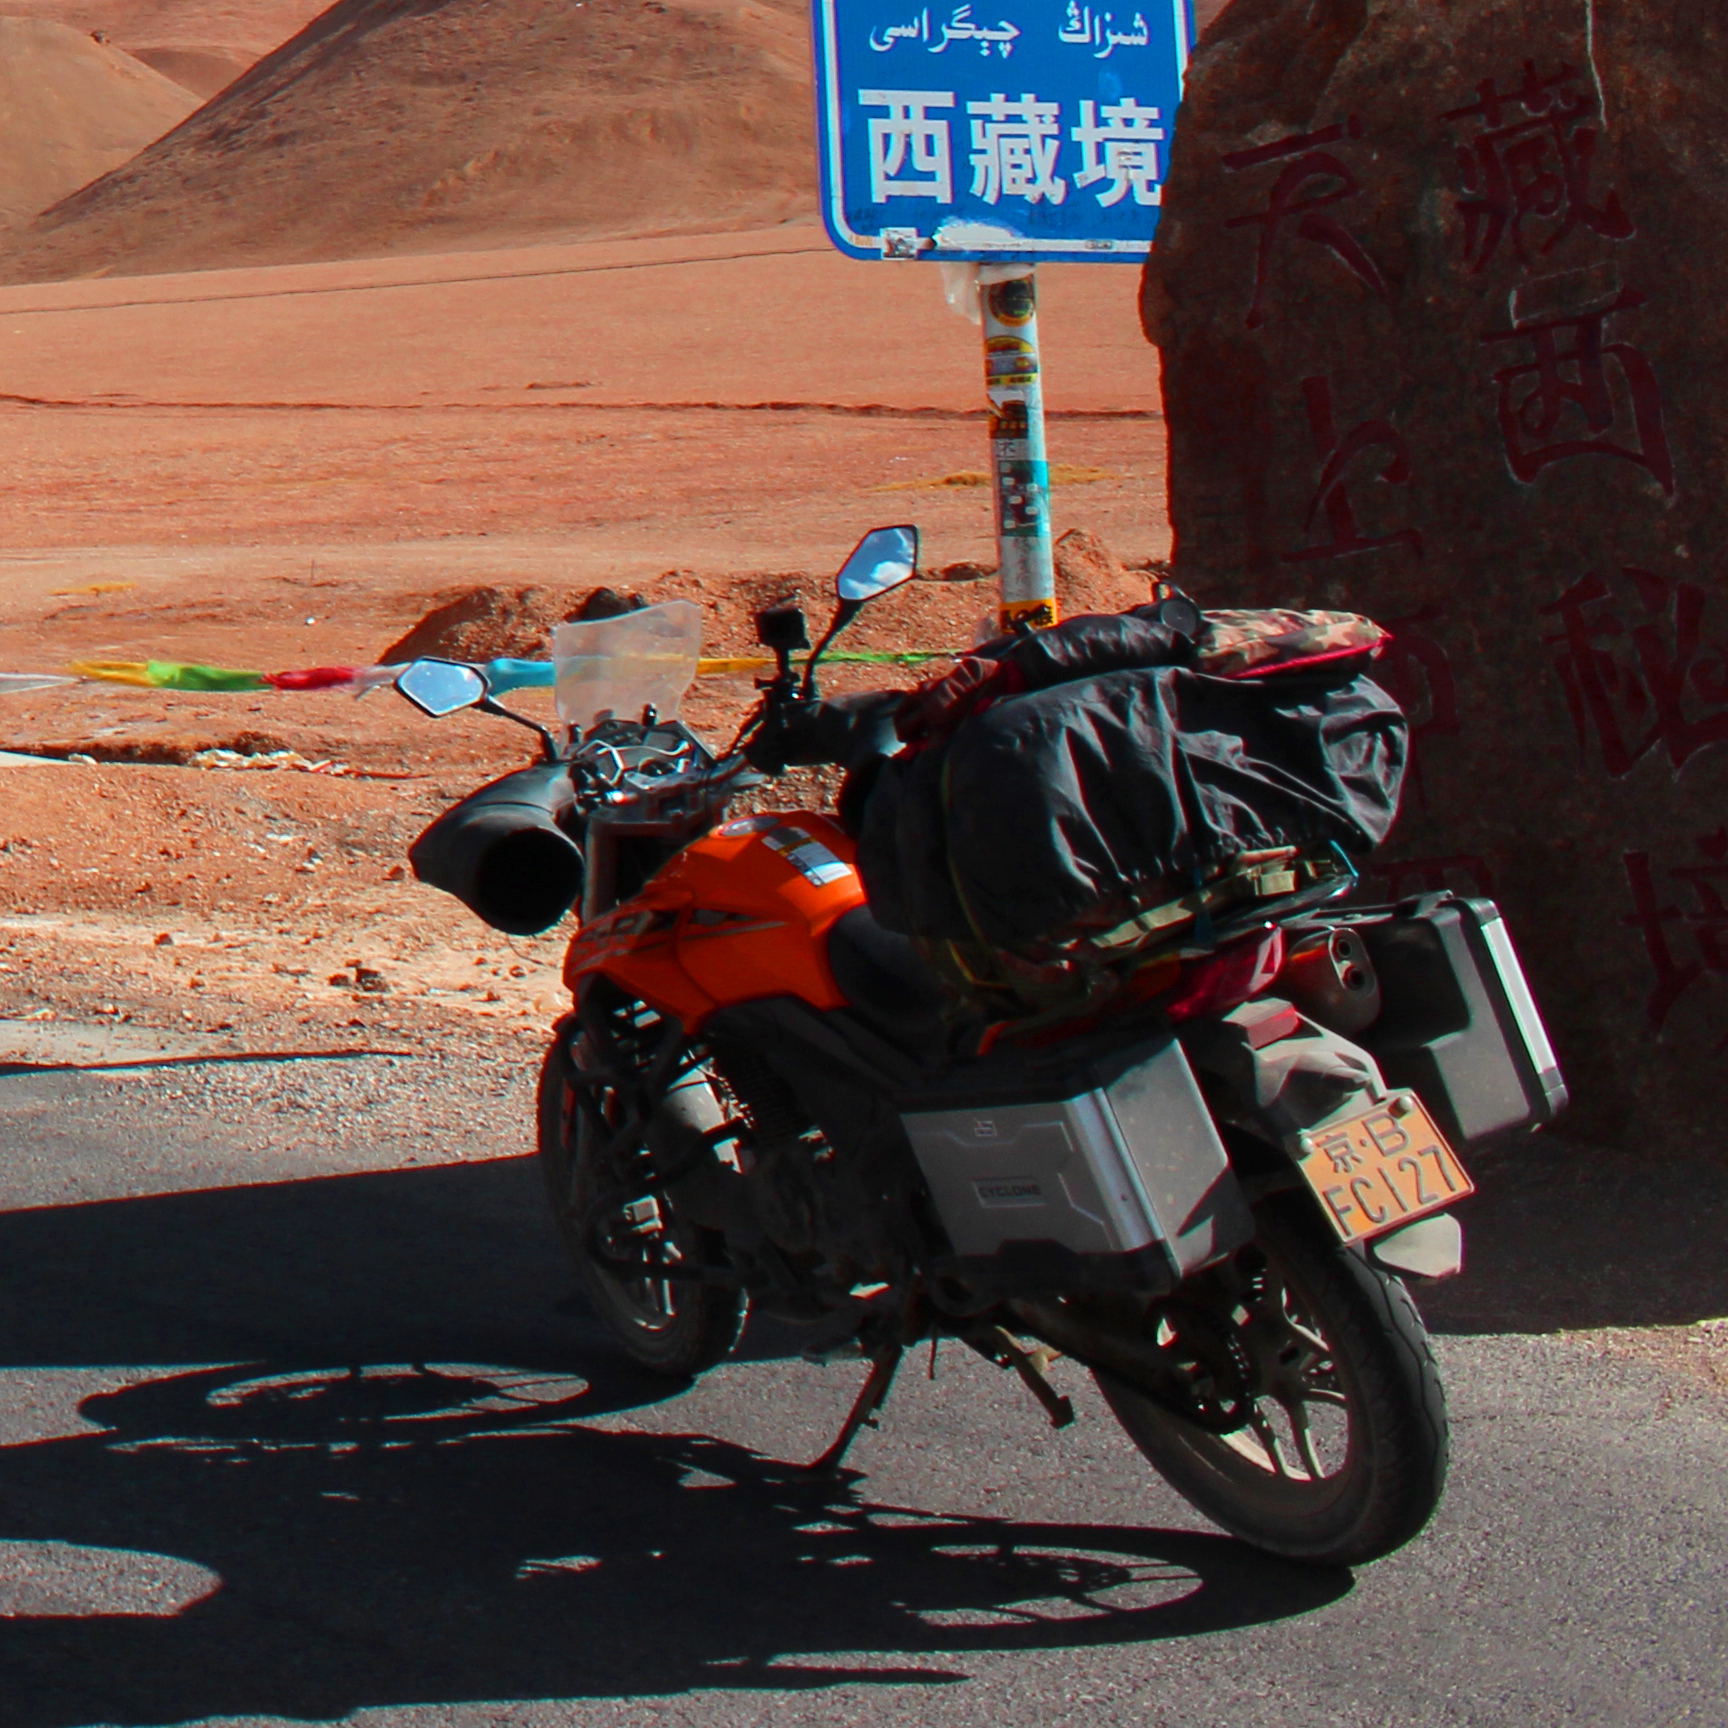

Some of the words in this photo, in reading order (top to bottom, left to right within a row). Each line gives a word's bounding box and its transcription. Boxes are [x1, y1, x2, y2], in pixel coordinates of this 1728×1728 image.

[857, 88, 1165, 208] 西藏境
[978, 1184, 1042, 1198] CYCLONE
[1322, 1145, 1456, 1238] FC127
